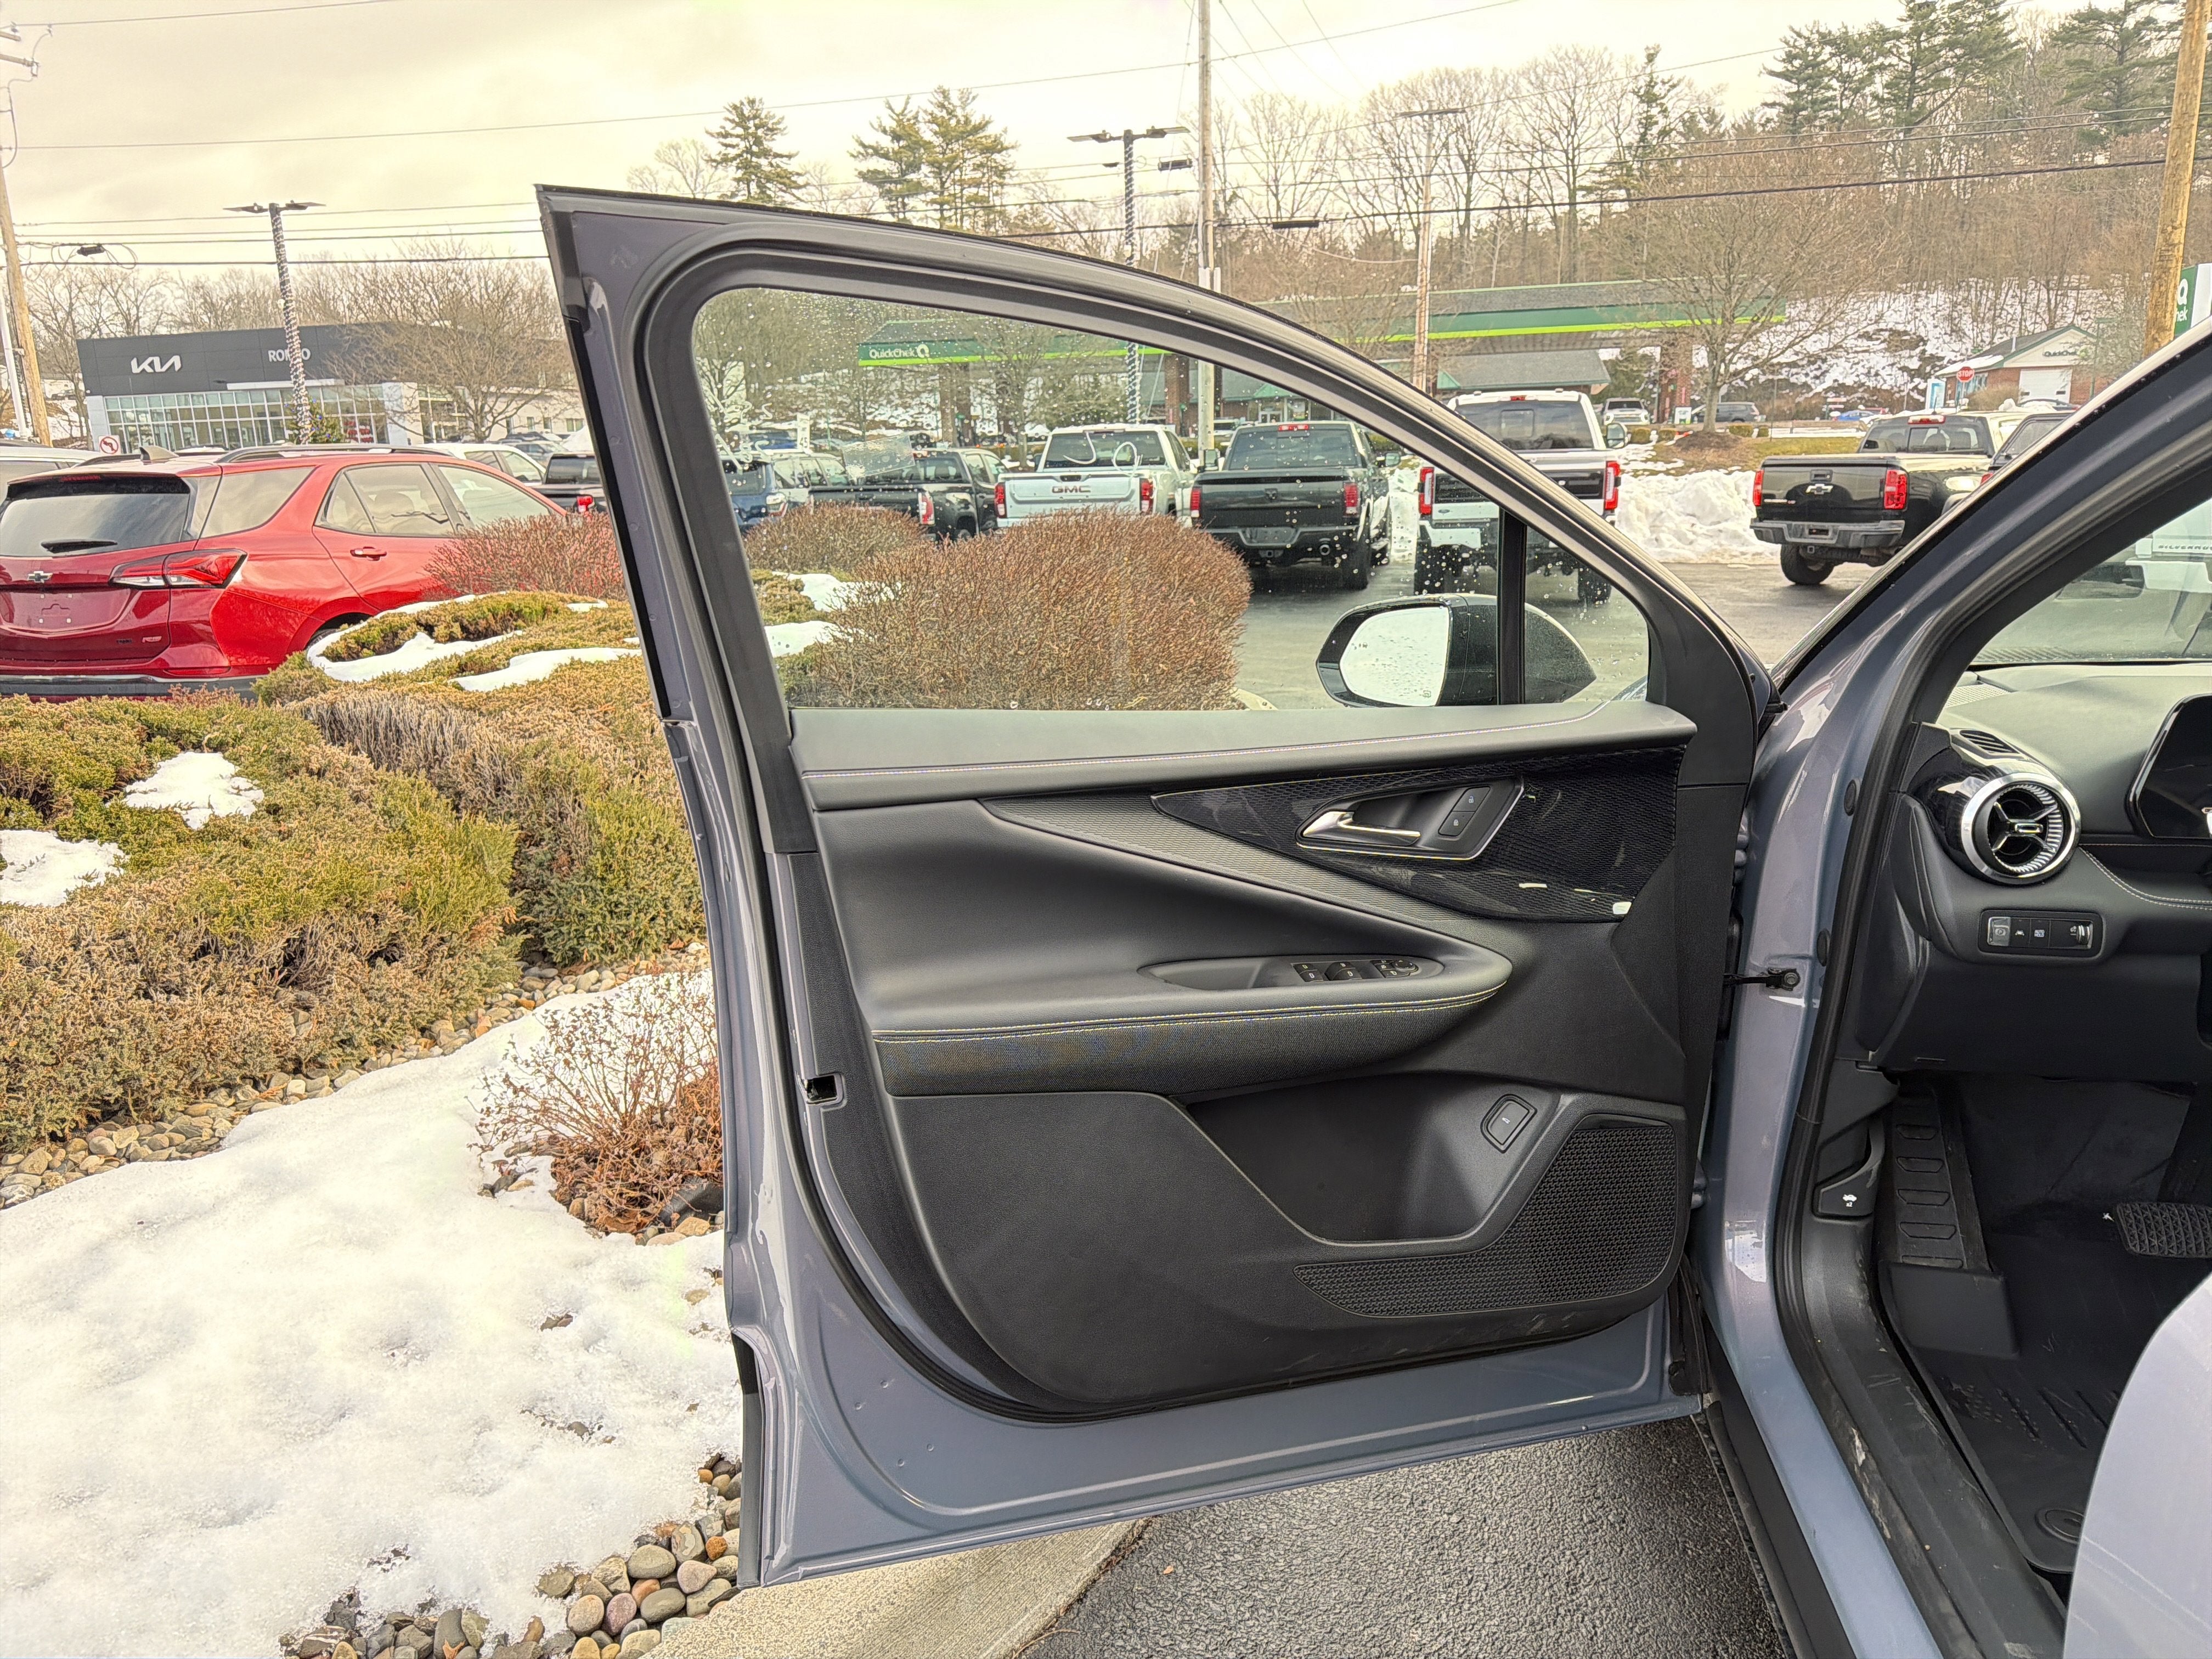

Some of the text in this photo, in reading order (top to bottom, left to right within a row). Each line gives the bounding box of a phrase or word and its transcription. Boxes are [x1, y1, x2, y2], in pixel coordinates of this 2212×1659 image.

[131, 356, 181, 373] KIA
[1957, 369, 1973, 377] STOP
[1052, 485, 1091, 493] GMC
